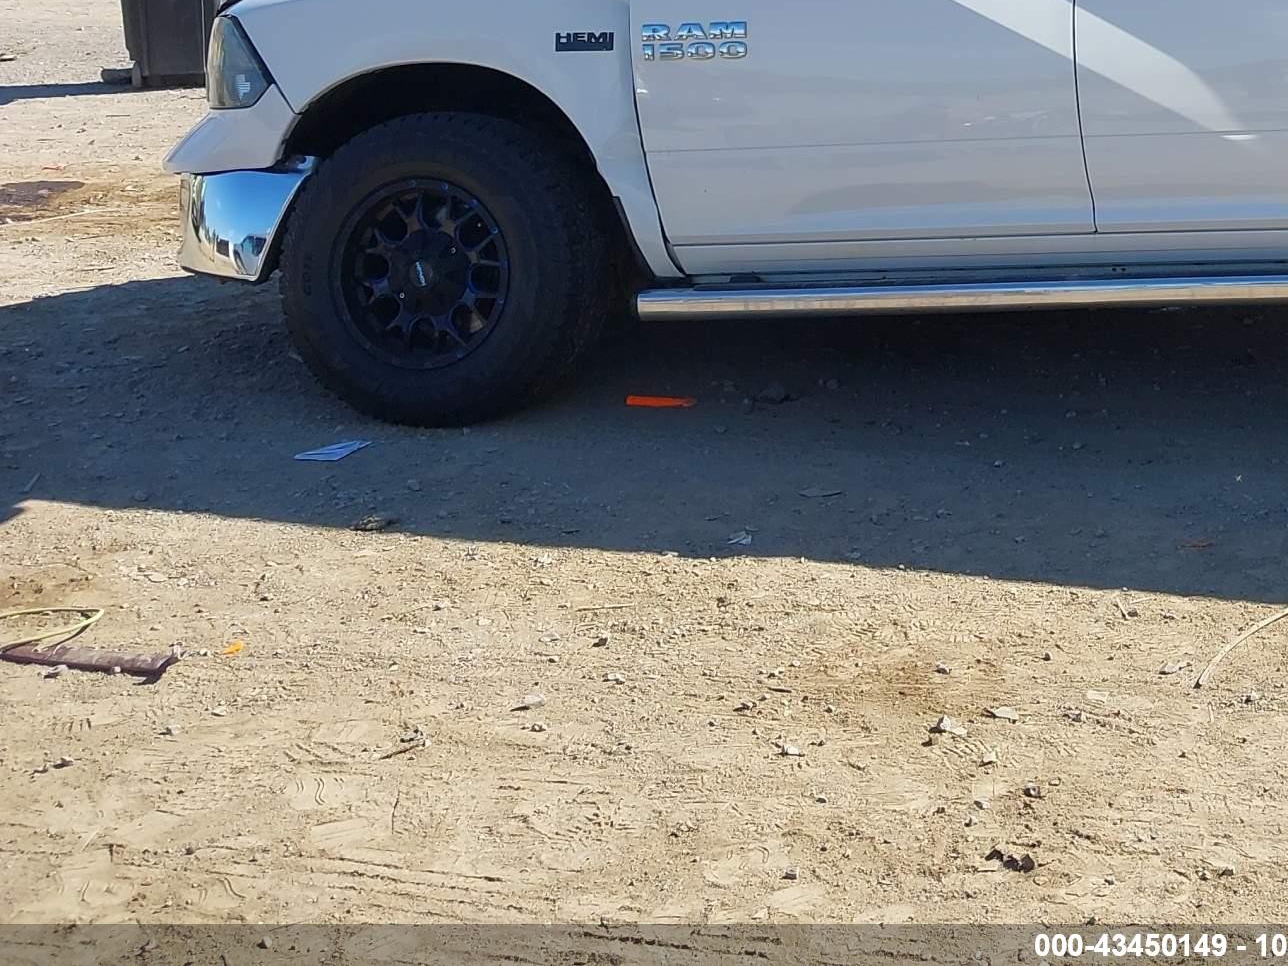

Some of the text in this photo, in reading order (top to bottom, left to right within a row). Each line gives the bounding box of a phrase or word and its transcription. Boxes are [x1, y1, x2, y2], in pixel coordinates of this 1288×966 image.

[556, 32, 614, 44] HEMI
[641, 21, 748, 41] RAM
[642, 41, 748, 61] 1500
